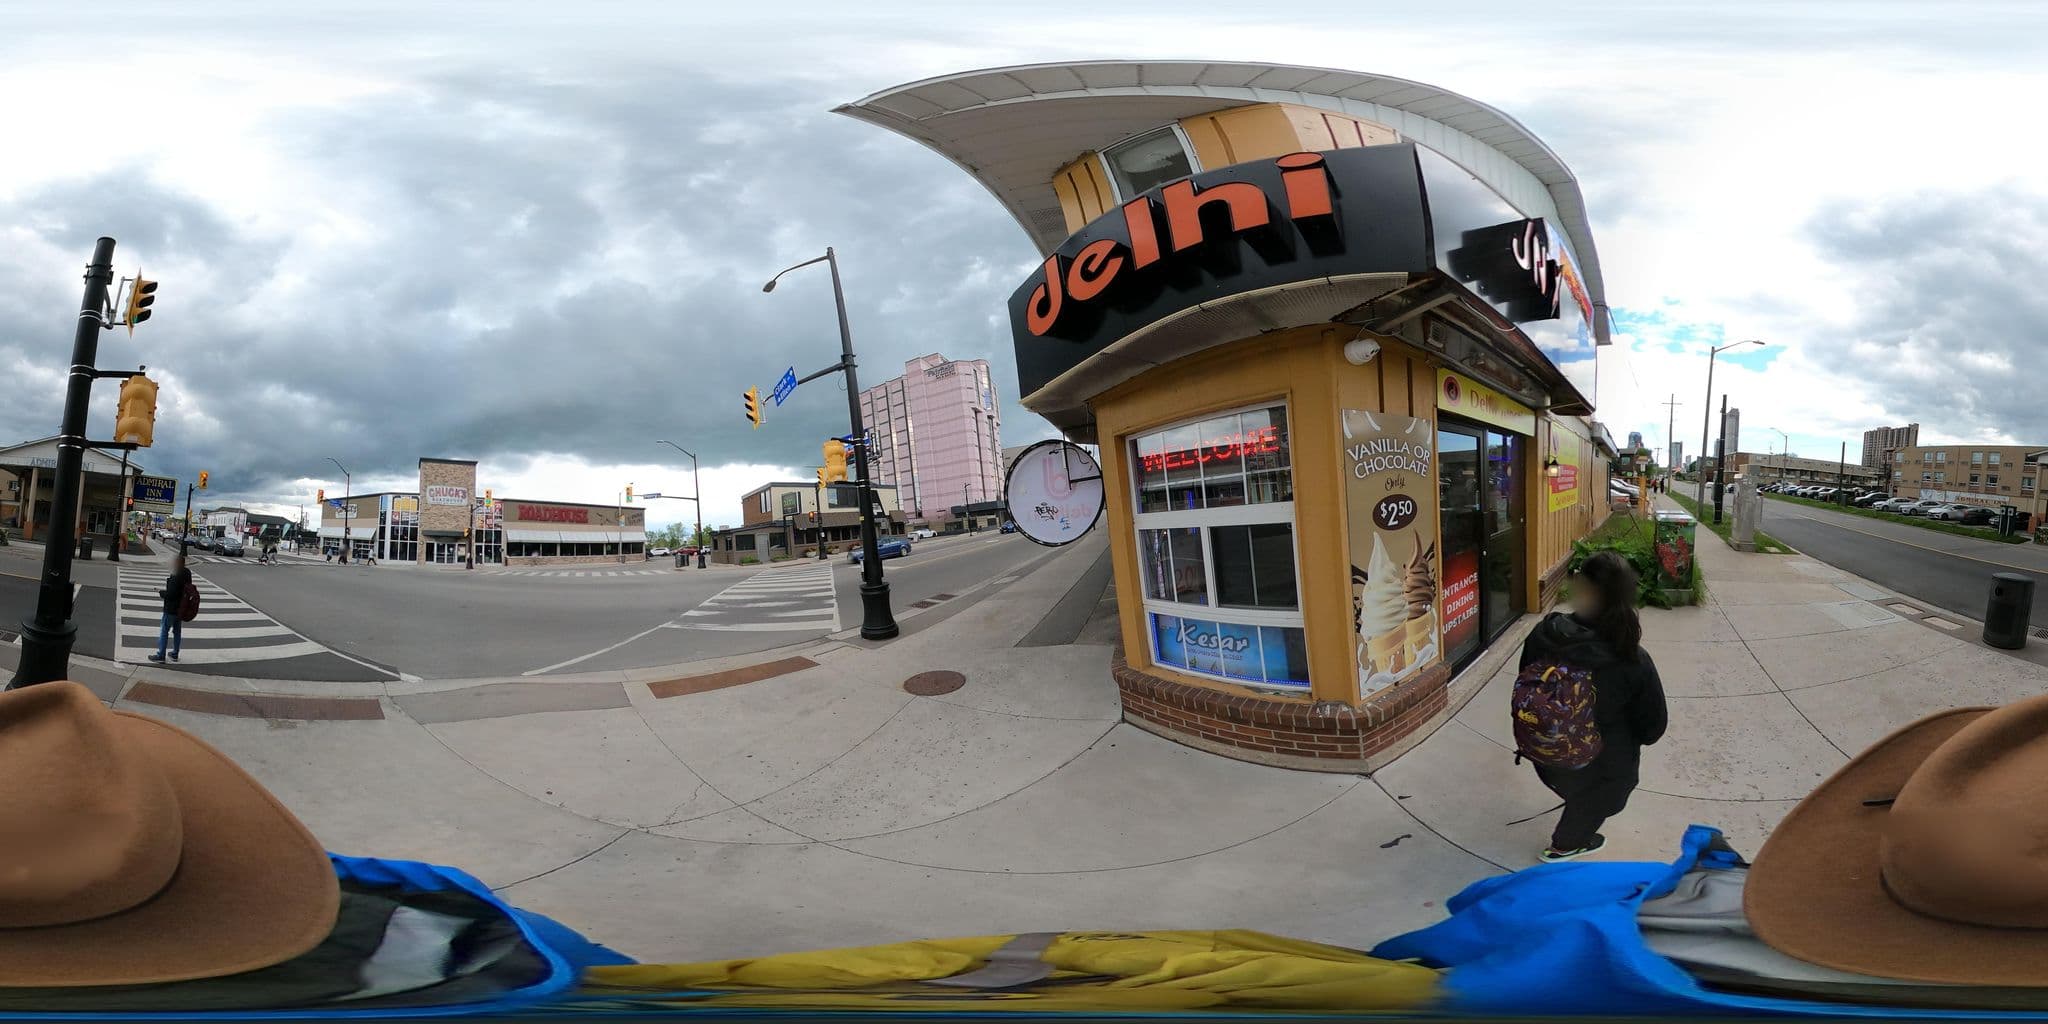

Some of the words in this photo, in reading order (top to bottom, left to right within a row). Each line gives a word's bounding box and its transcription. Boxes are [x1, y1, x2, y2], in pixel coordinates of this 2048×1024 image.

[1026, 152, 1333, 336] delhi
[1142, 425, 1280, 472] WELCOME
[1347, 438, 1411, 461] VANILLA
[1413, 445, 1430, 463] OR
[1354, 455, 1429, 479] CHOCOLATE
[136, 478, 174, 489] ADMIRAL
[146, 487, 162, 497] INN
[428, 486, 467, 499] CHUCK'S
[1384, 474, 1406, 491] Only
[518, 504, 588, 524] ROADHOUSE
[1442, 572, 1478, 600] ENTRANCE
[1446, 591, 1474, 615] DINING
[1442, 605, 1479, 634] UPSTAIRS
[1176, 623, 1248, 652] Kesar
